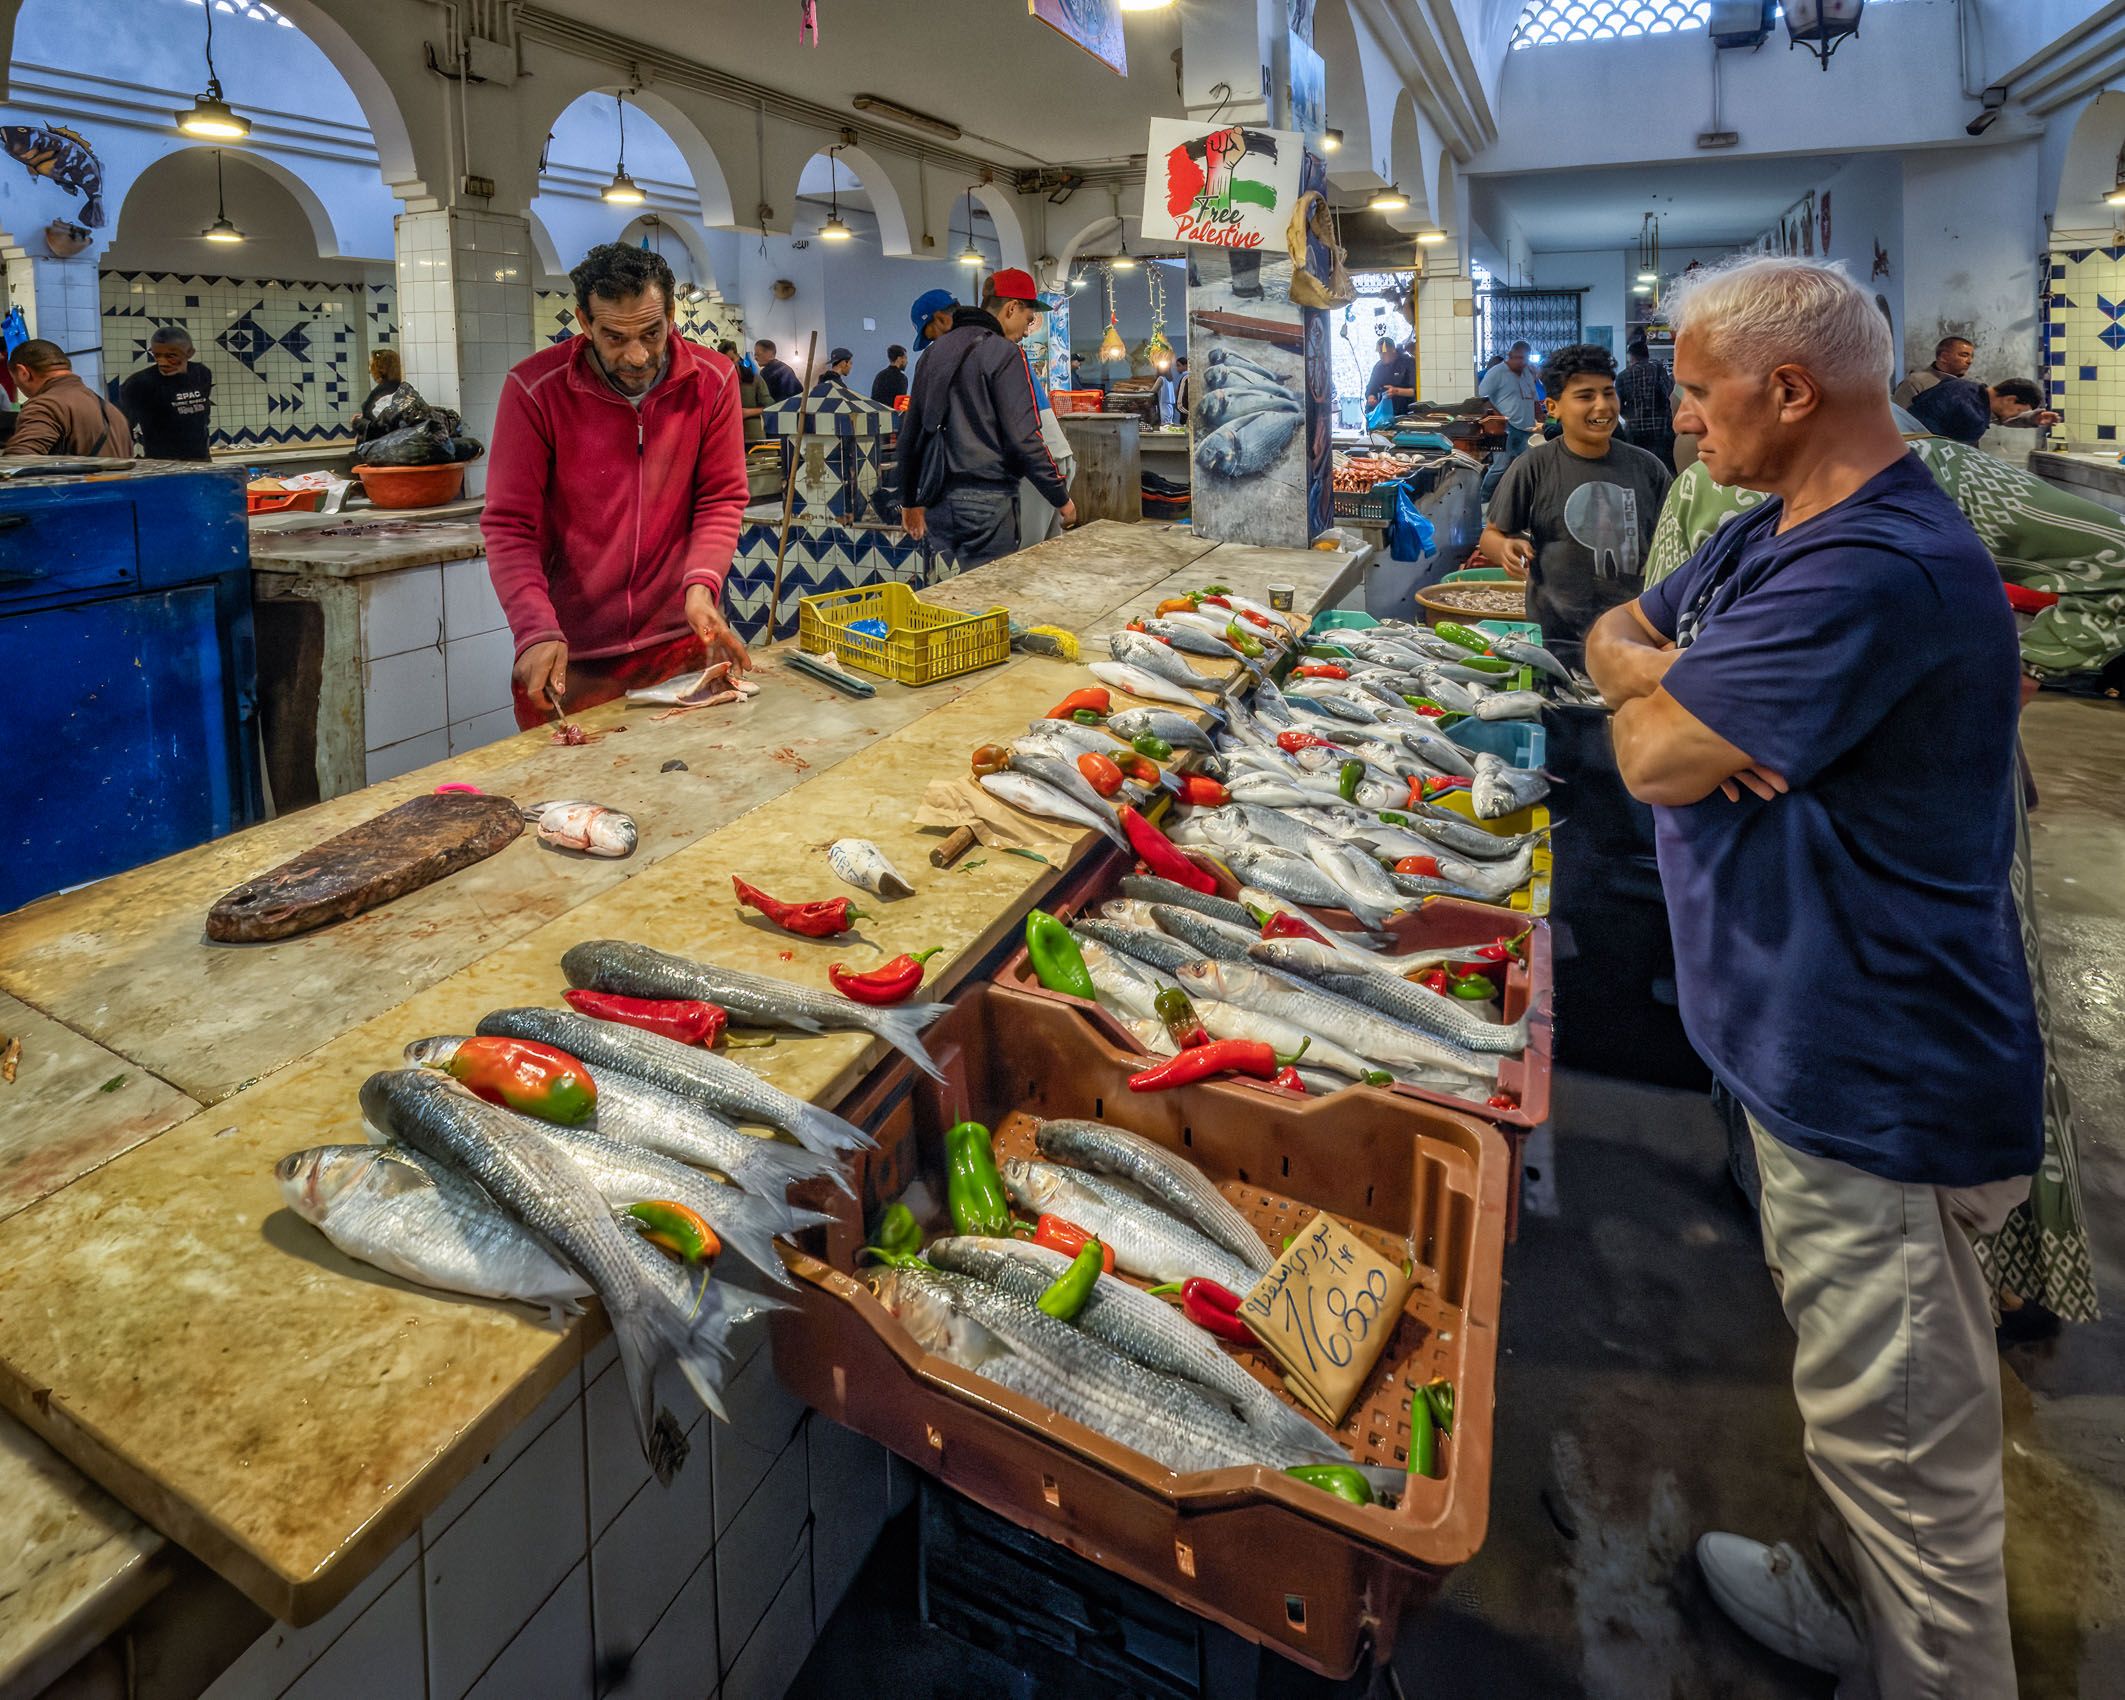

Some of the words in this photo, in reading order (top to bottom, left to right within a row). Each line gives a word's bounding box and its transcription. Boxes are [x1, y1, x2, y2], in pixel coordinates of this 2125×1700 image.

[1261, 64, 1272, 98] 18
[1194, 195, 1245, 225] Free
[1173, 215, 1265, 249] Palestine
[176, 390, 202, 401] 2PAC
